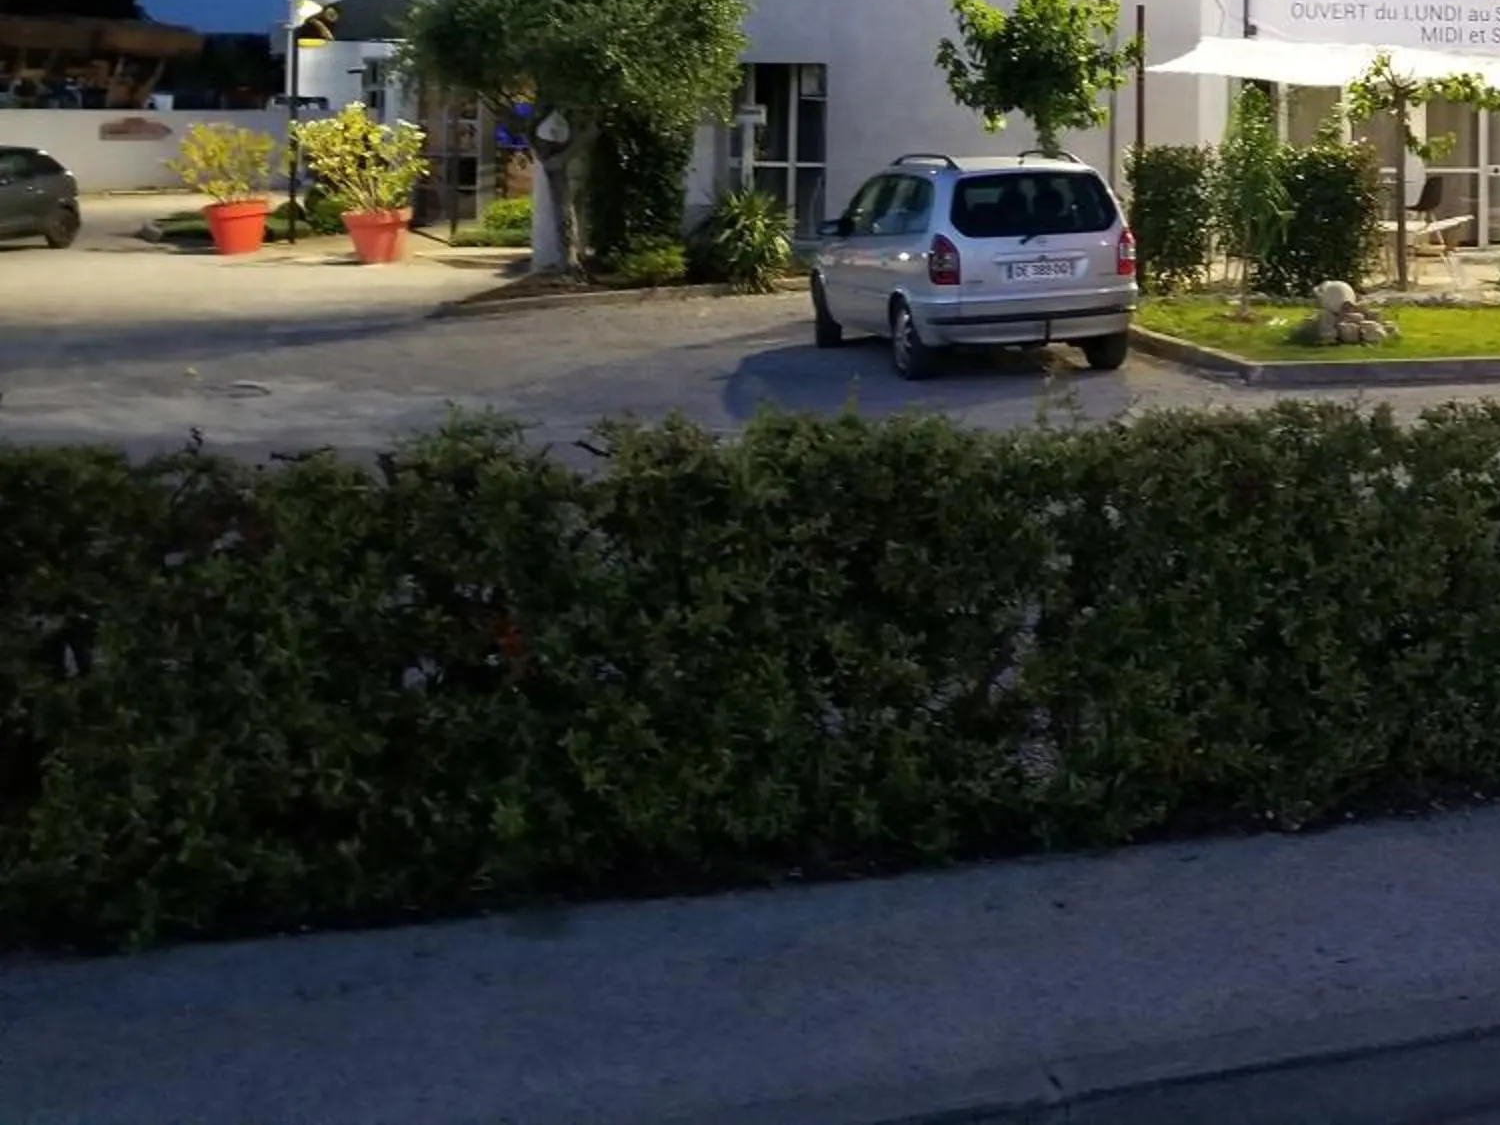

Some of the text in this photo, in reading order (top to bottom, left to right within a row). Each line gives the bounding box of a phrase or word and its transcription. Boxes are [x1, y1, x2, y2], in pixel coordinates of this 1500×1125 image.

[1291, 1, 1367, 20] OUVERT
[1375, 3, 1397, 20] du
[1404, 4, 1462, 22] LUNDI
[1468, 8, 1490, 22] au
[1421, 26, 1463, 43] MIDI
[1469, 29, 1486, 44] et
